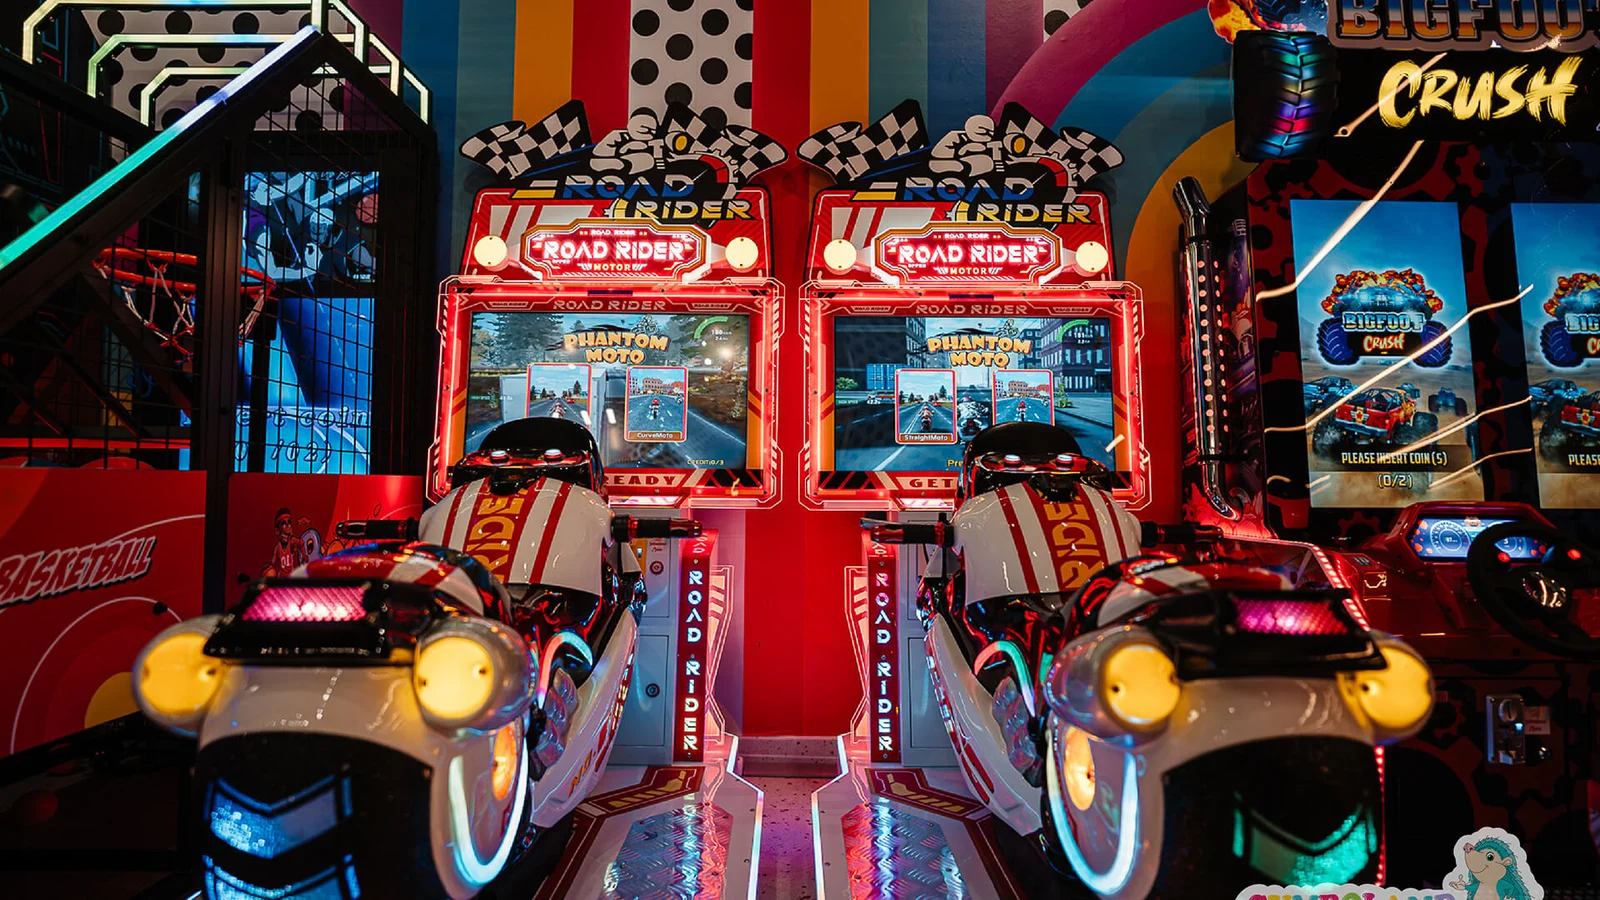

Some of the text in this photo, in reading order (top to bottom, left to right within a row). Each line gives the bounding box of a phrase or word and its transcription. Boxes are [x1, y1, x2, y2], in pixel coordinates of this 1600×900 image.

[1339, 0, 1600, 39] BIGFOO
[1378, 55, 1583, 129] CRUSH
[563, 174, 695, 199] ROAD
[904, 176, 1035, 201] ROAD
[634, 200, 752, 220] RIDER
[976, 203, 1094, 224] RIDER
[543, 241, 685, 260] ROAD RIDER
[898, 245, 1040, 263] ROAD RIDER
[593, 263, 631, 271] MOTOR
[950, 267, 988, 275] MOTOR
[553, 300, 666, 310] ROAD RIDER
[915, 304, 1028, 314] ROAD RIDER
[1344, 313, 1424, 331] BIGFOOT
[563, 331, 670, 351] PHANTOM
[927, 334, 1033, 354] PHANTOM
[1363, 332, 1405, 352] CRUSH
[586, 349, 646, 365] MOTO
[950, 352, 1011, 368] MOTO
[1341, 452, 1375, 464] PLEASE
[1376, 452, 1408, 464] INSERT
[909, 478, 954, 488] GET
[1378, 474, 1413, 488] (0/2)
[0, 535, 156, 606] BASKETBALL
[683, 570, 703, 751] ROAD RIDER
[874, 572, 893, 751] ROAD RIDER
